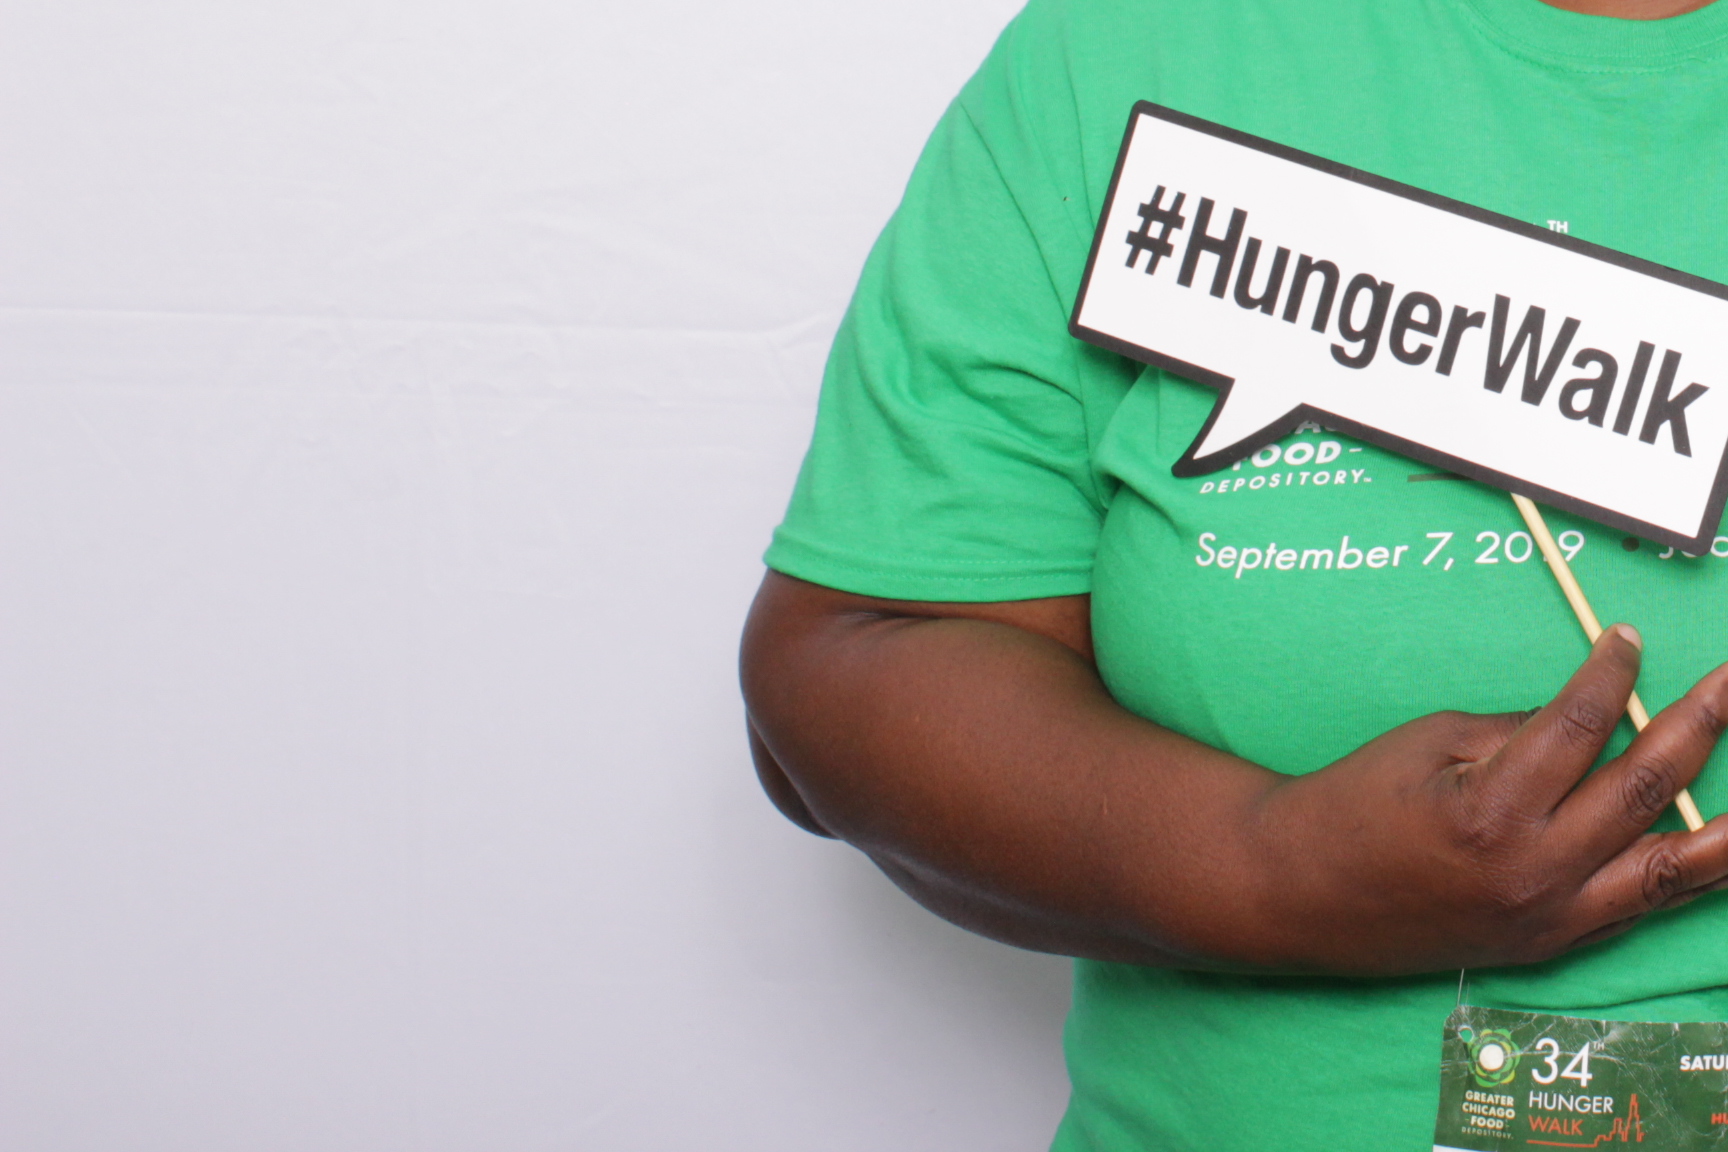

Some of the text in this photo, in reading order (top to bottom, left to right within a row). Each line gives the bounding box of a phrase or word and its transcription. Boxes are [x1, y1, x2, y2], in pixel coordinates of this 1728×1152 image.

[1123, 184, 1710, 459] #HungerWalk
[1195, 532, 1409, 579] September
[1422, 531, 1454, 571] 7,
[1474, 530, 1585, 564] 209
[1465, 1089, 1514, 1107] GREATER
[1529, 1090, 1614, 1114] HUNGER
[1462, 1101, 1516, 1120] CHICAGO
[1470, 1115, 1504, 1130] FOOD
[1528, 1115, 1584, 1136] WALK
